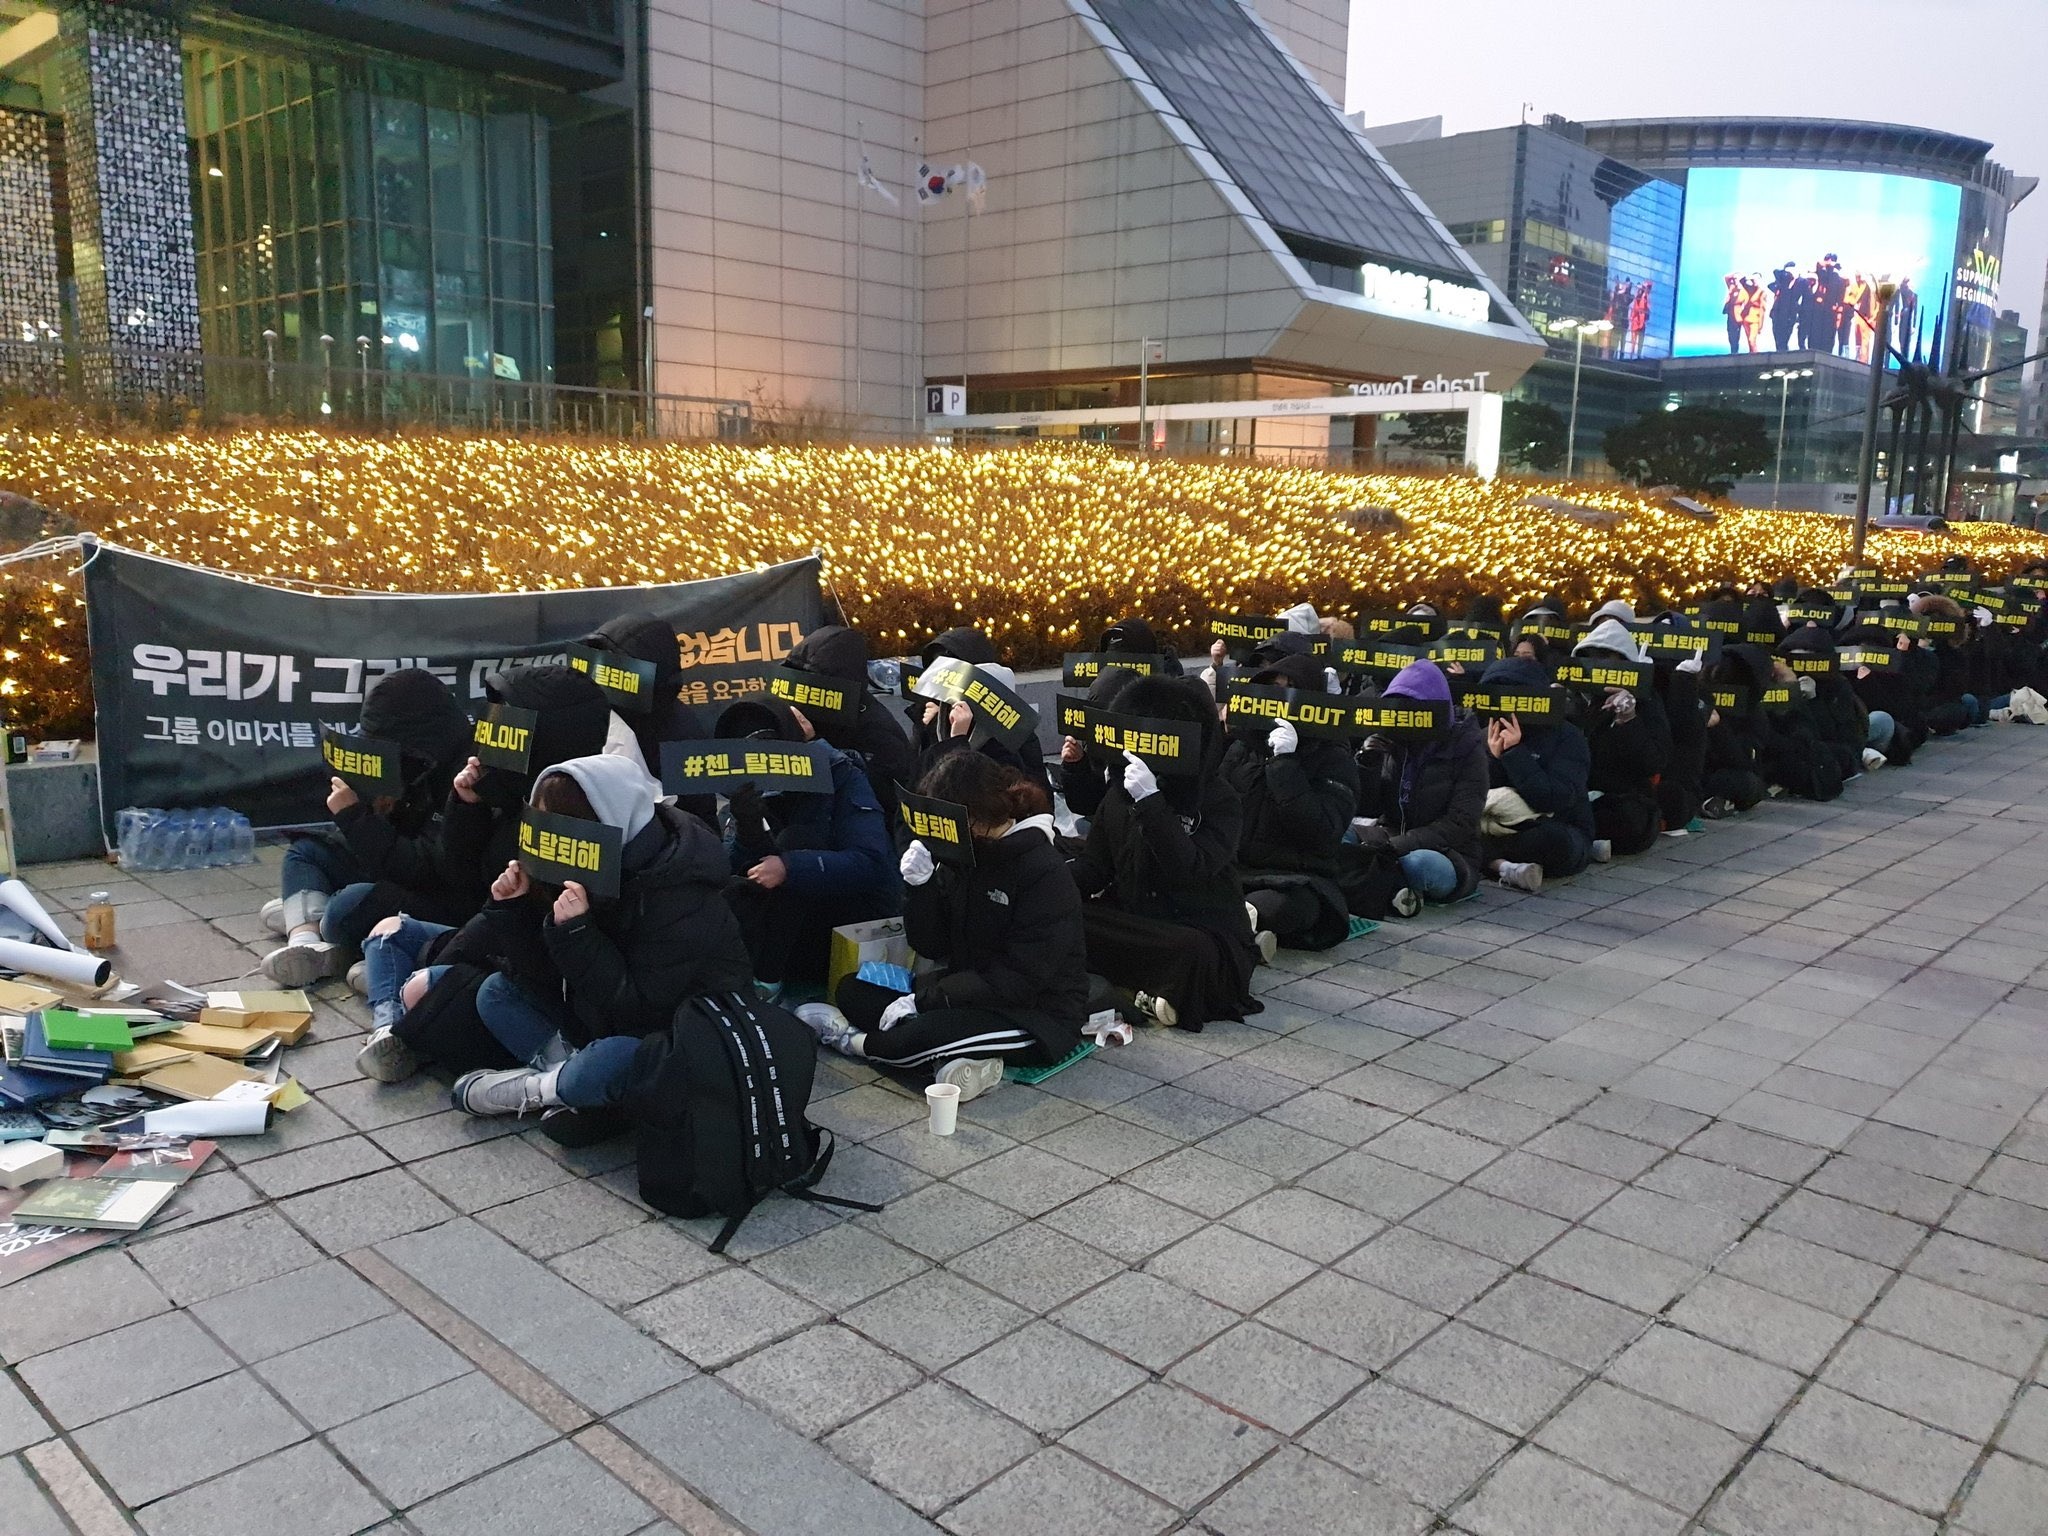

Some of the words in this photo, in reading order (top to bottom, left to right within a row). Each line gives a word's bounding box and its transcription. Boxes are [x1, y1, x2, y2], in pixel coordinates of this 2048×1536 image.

[132, 643, 301, 703] 우리가
[1556, 666, 1640, 688] #첸_탈퇴해
[770, 677, 844, 711] #첸_탈퇴해
[1229, 694, 1346, 727] #CHEN_OUT
[1462, 693, 1551, 713] #첸_탈퇴해
[143, 715, 202, 746] 그룹
[206, 718, 317, 748] 이미지를
[1355, 708, 1433, 729] #첸_탈퇴해
[1094, 723, 1180, 758] #첸_탈퇴해
[683, 752, 814, 778] #첸_탈퇴해
